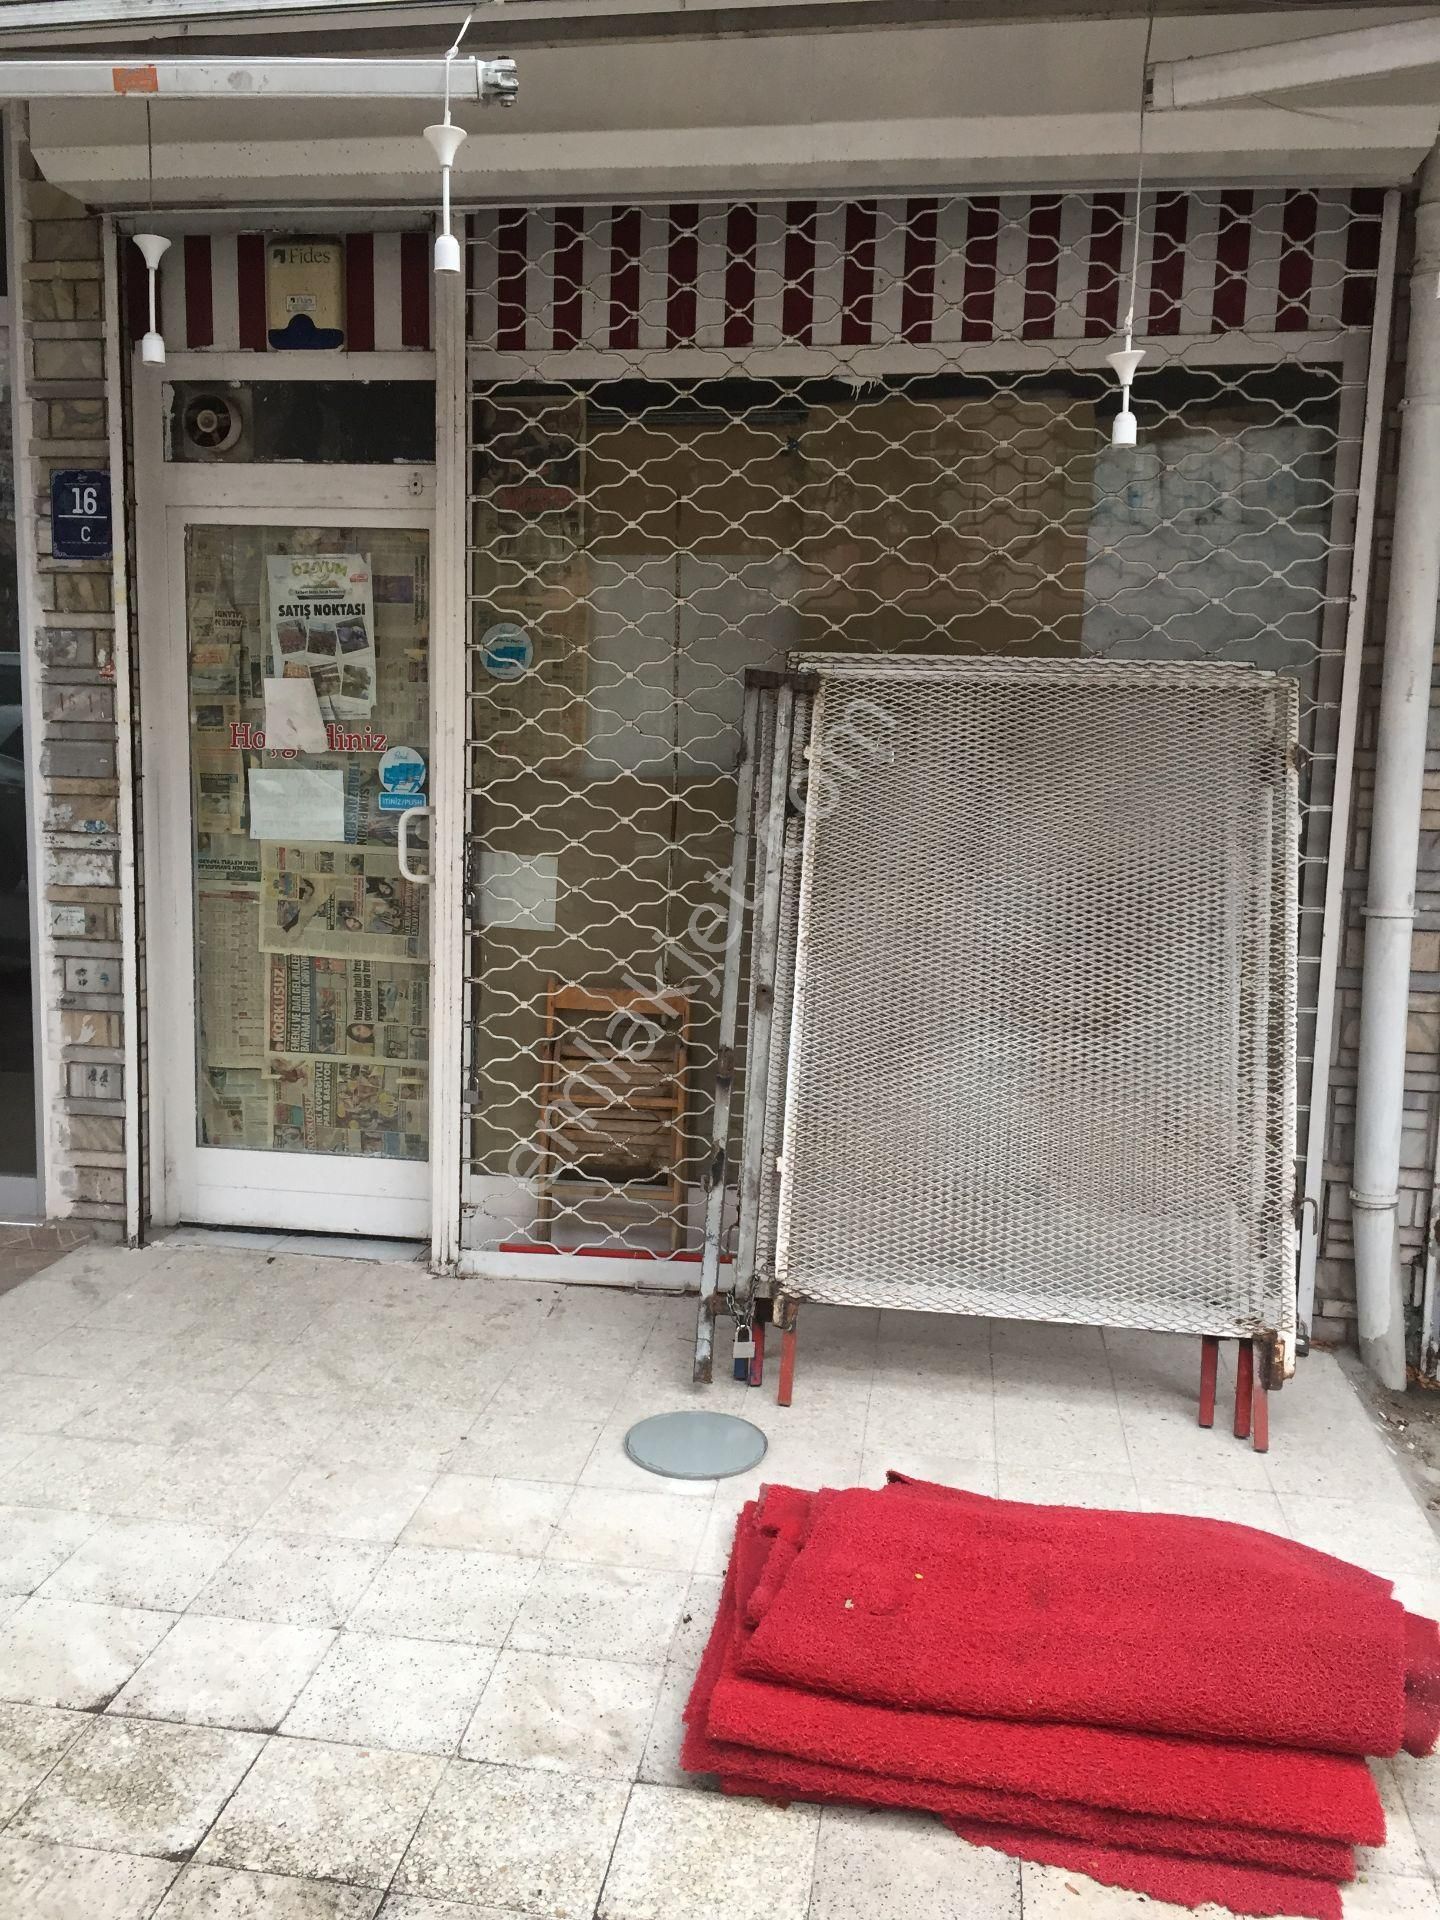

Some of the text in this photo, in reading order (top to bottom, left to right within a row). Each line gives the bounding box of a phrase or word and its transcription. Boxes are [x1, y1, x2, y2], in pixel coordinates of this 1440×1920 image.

[289, 247, 331, 264] Fides
[71, 487, 97, 515] 16
[81, 526, 91, 542] C
[278, 603, 366, 620] SATIŞ NOKTASI
[273, 968, 285, 1042] KORKUSUZ
